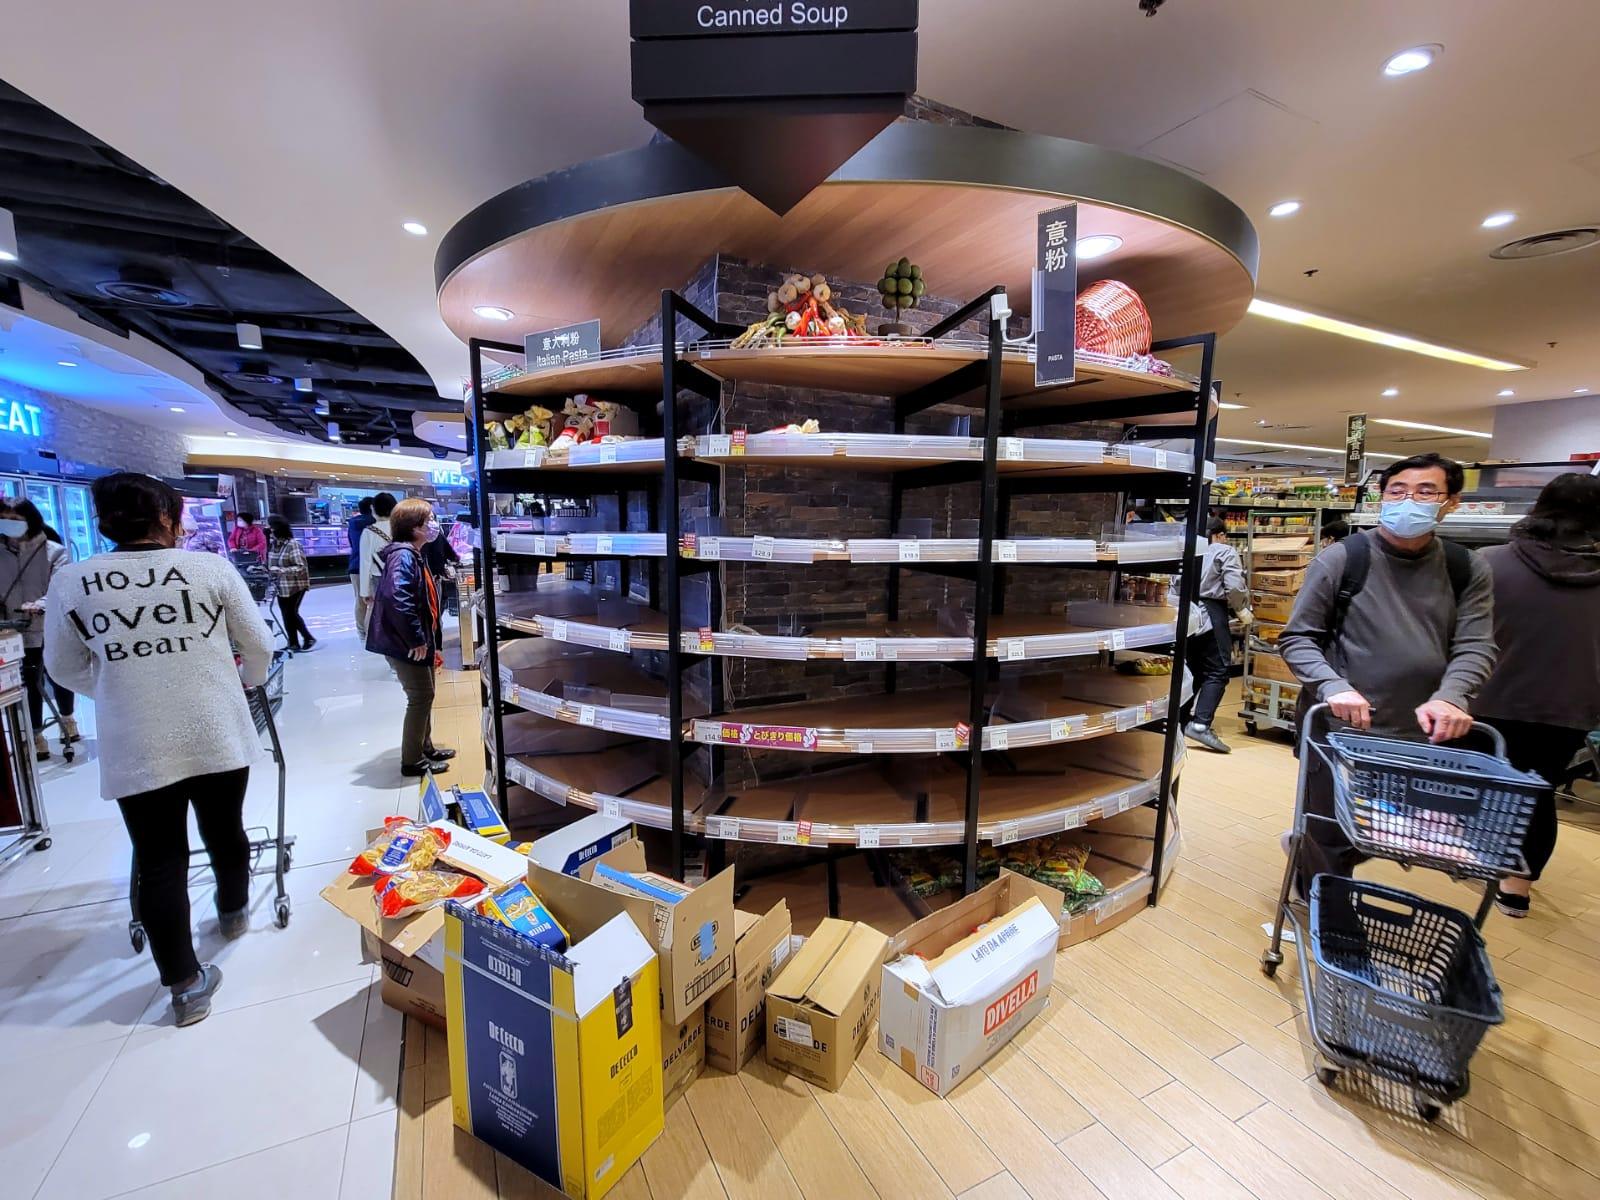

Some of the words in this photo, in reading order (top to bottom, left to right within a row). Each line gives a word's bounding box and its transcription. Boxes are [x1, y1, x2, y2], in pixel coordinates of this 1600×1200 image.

[697, 3, 782, 27] Canned
[790, 2, 848, 28] Soup
[1044, 220, 1068, 272] 意粉
[542, 331, 580, 352] 意大利粉
[536, 353, 561, 368] Italian
[562, 347, 588, 361] Pasta
[82, 566, 190, 596] HOJA
[67, 589, 224, 642] lovely
[105, 634, 194, 662] Bear
[753, 730, 802, 743] とびきり価格
[971, 944, 991, 962] LATO
[987, 976, 1036, 1028] DIVELLA
[664, 1024, 702, 1070] DELVERDE
